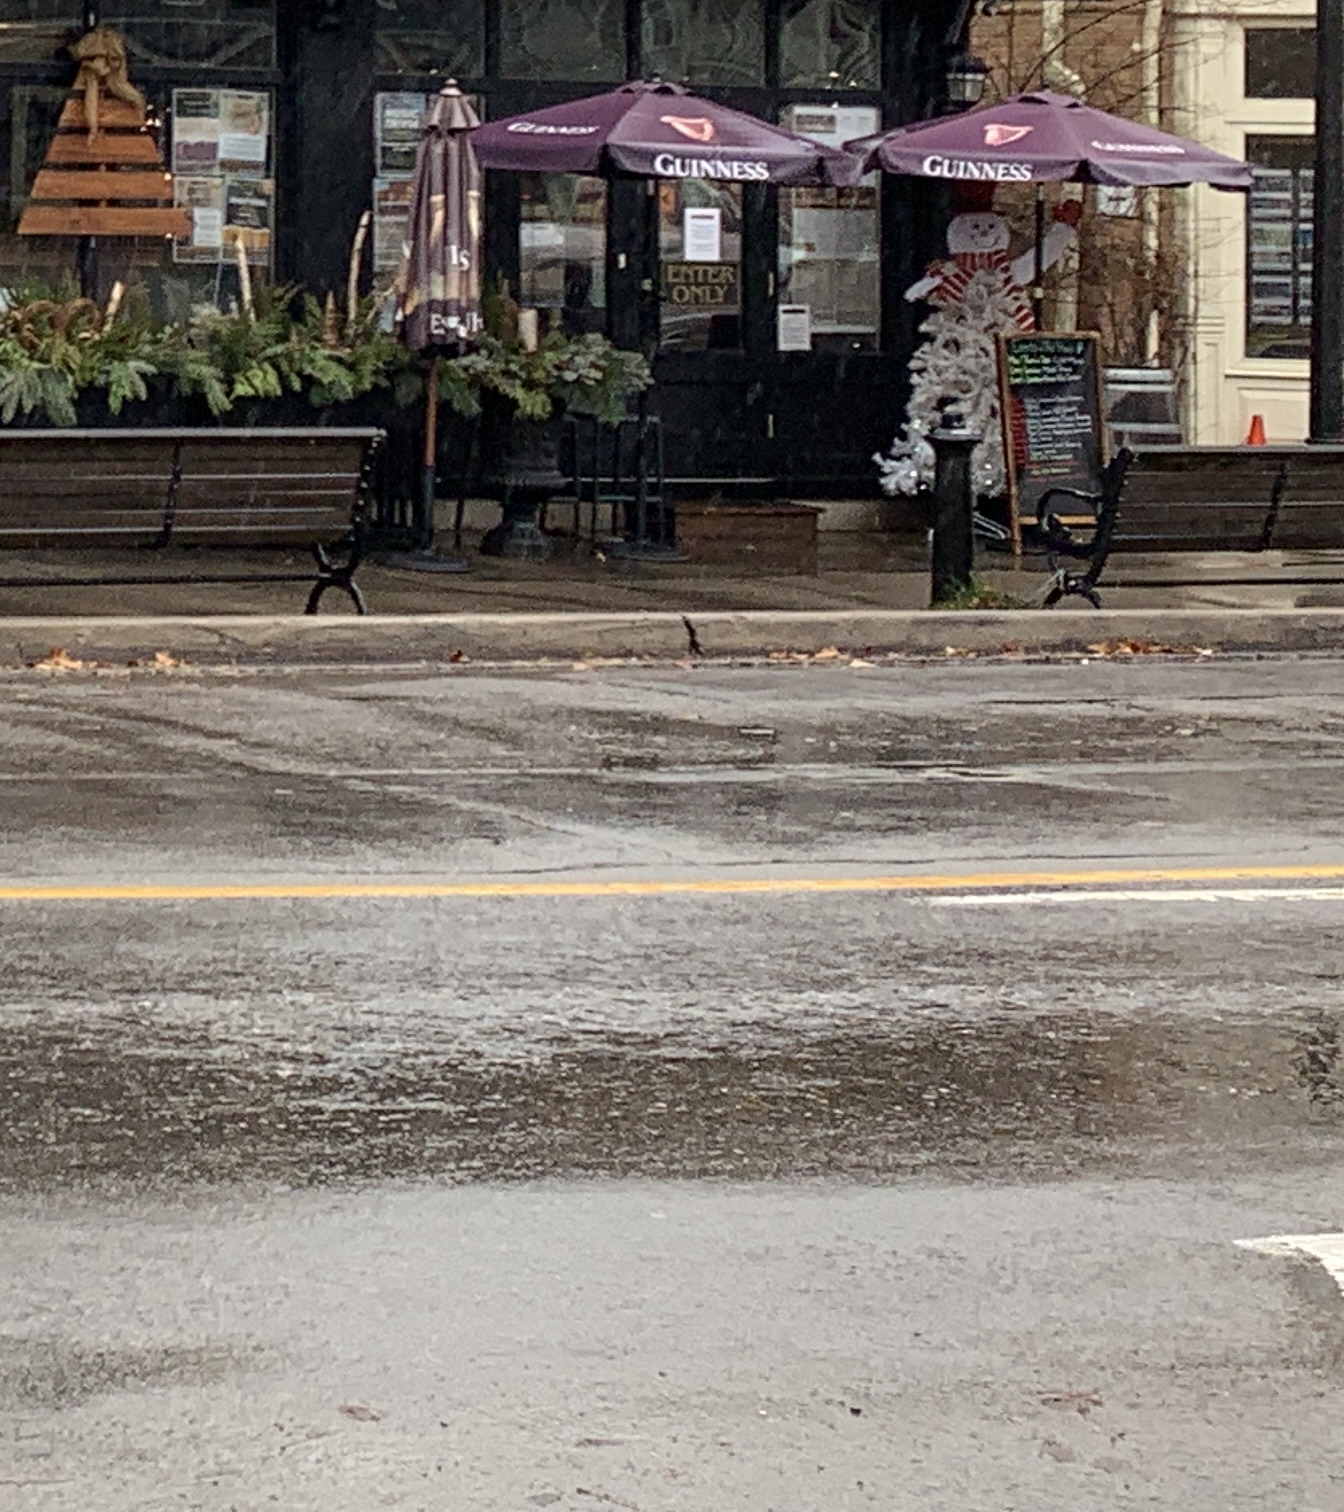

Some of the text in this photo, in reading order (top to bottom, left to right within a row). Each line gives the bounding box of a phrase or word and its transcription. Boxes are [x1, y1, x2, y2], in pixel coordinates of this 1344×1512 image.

[653, 153, 770, 180] GUINNESS
[922, 155, 1033, 181] GUINNESS
[666, 264, 735, 284] ENTER
[672, 284, 728, 304] ONLY
